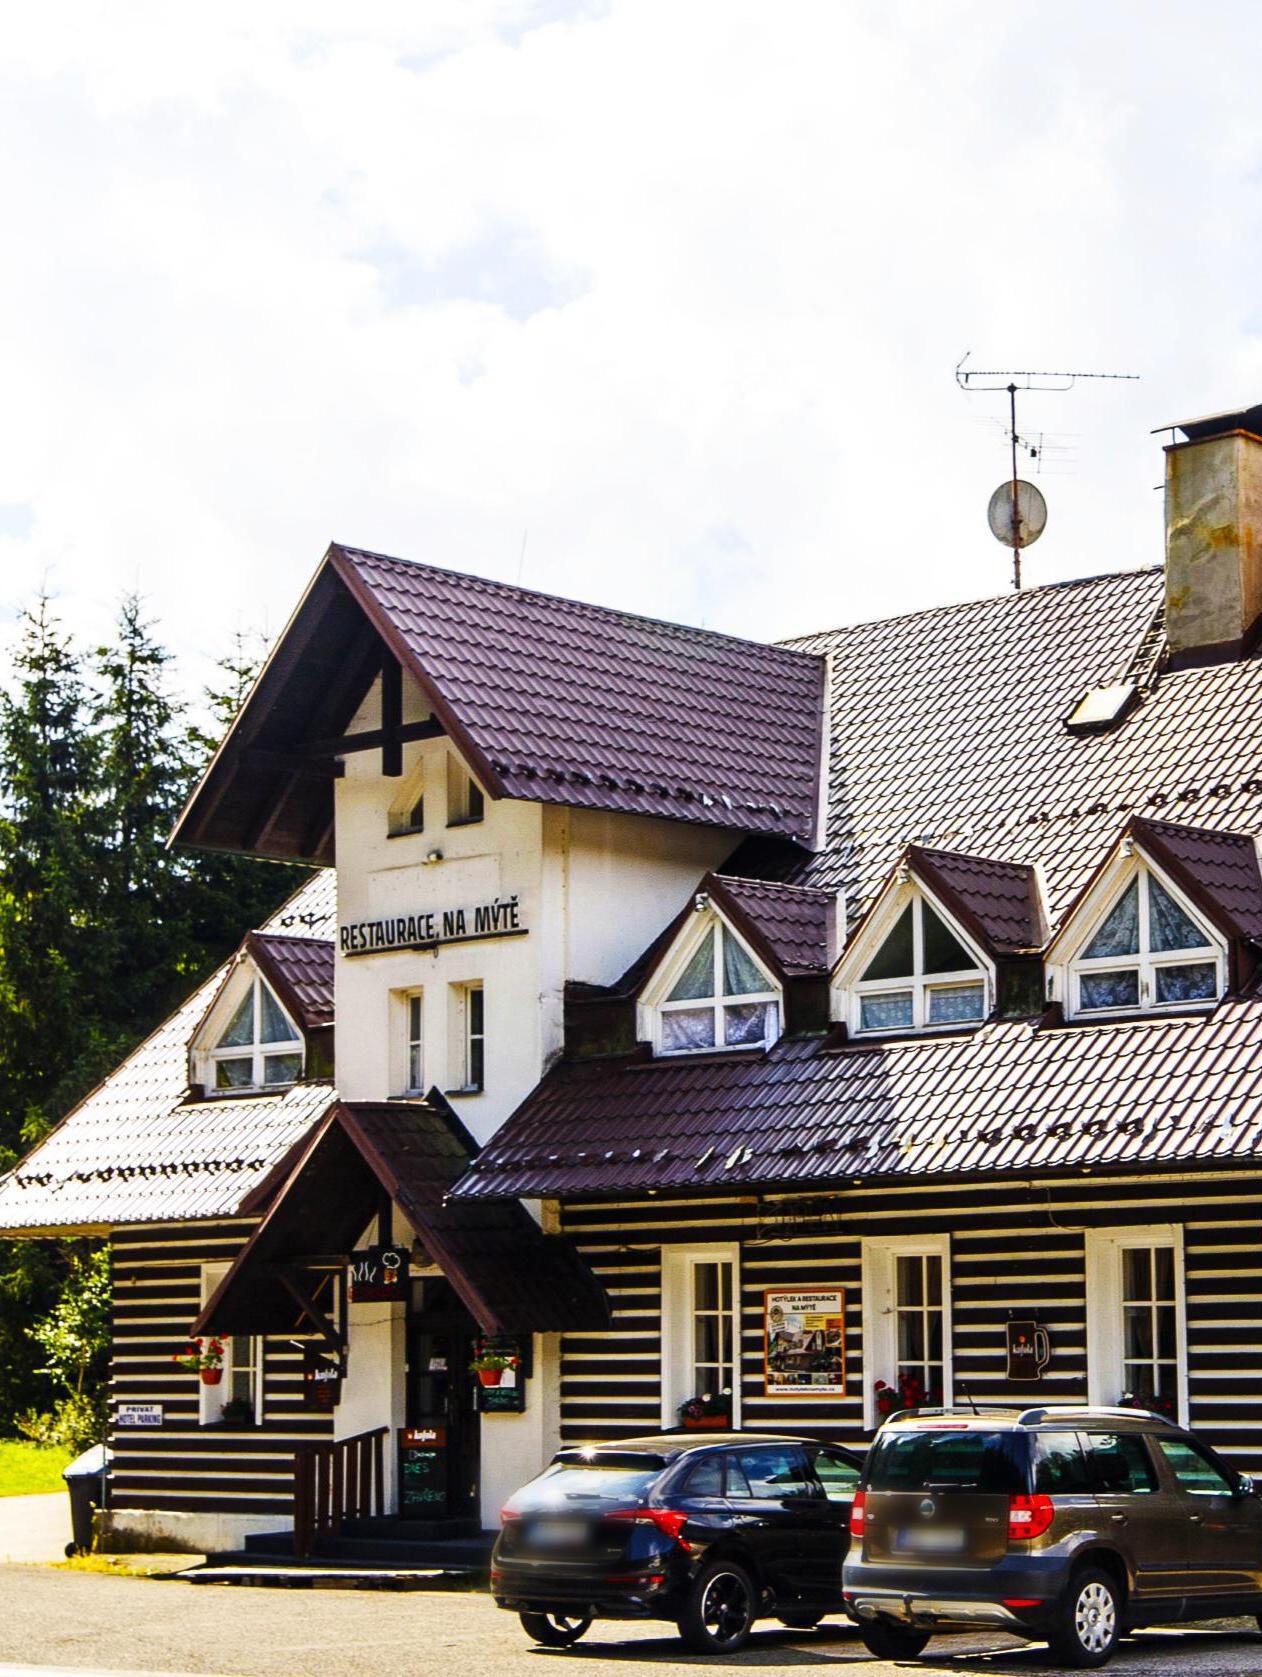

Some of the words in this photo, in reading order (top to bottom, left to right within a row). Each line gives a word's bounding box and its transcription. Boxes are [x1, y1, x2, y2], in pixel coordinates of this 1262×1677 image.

[443, 909, 466, 937] NA
[474, 895, 520, 933] MÝTĚ
[119, 1414, 136, 1424] HOTEL
[138, 1414, 161, 1424] PARKING
